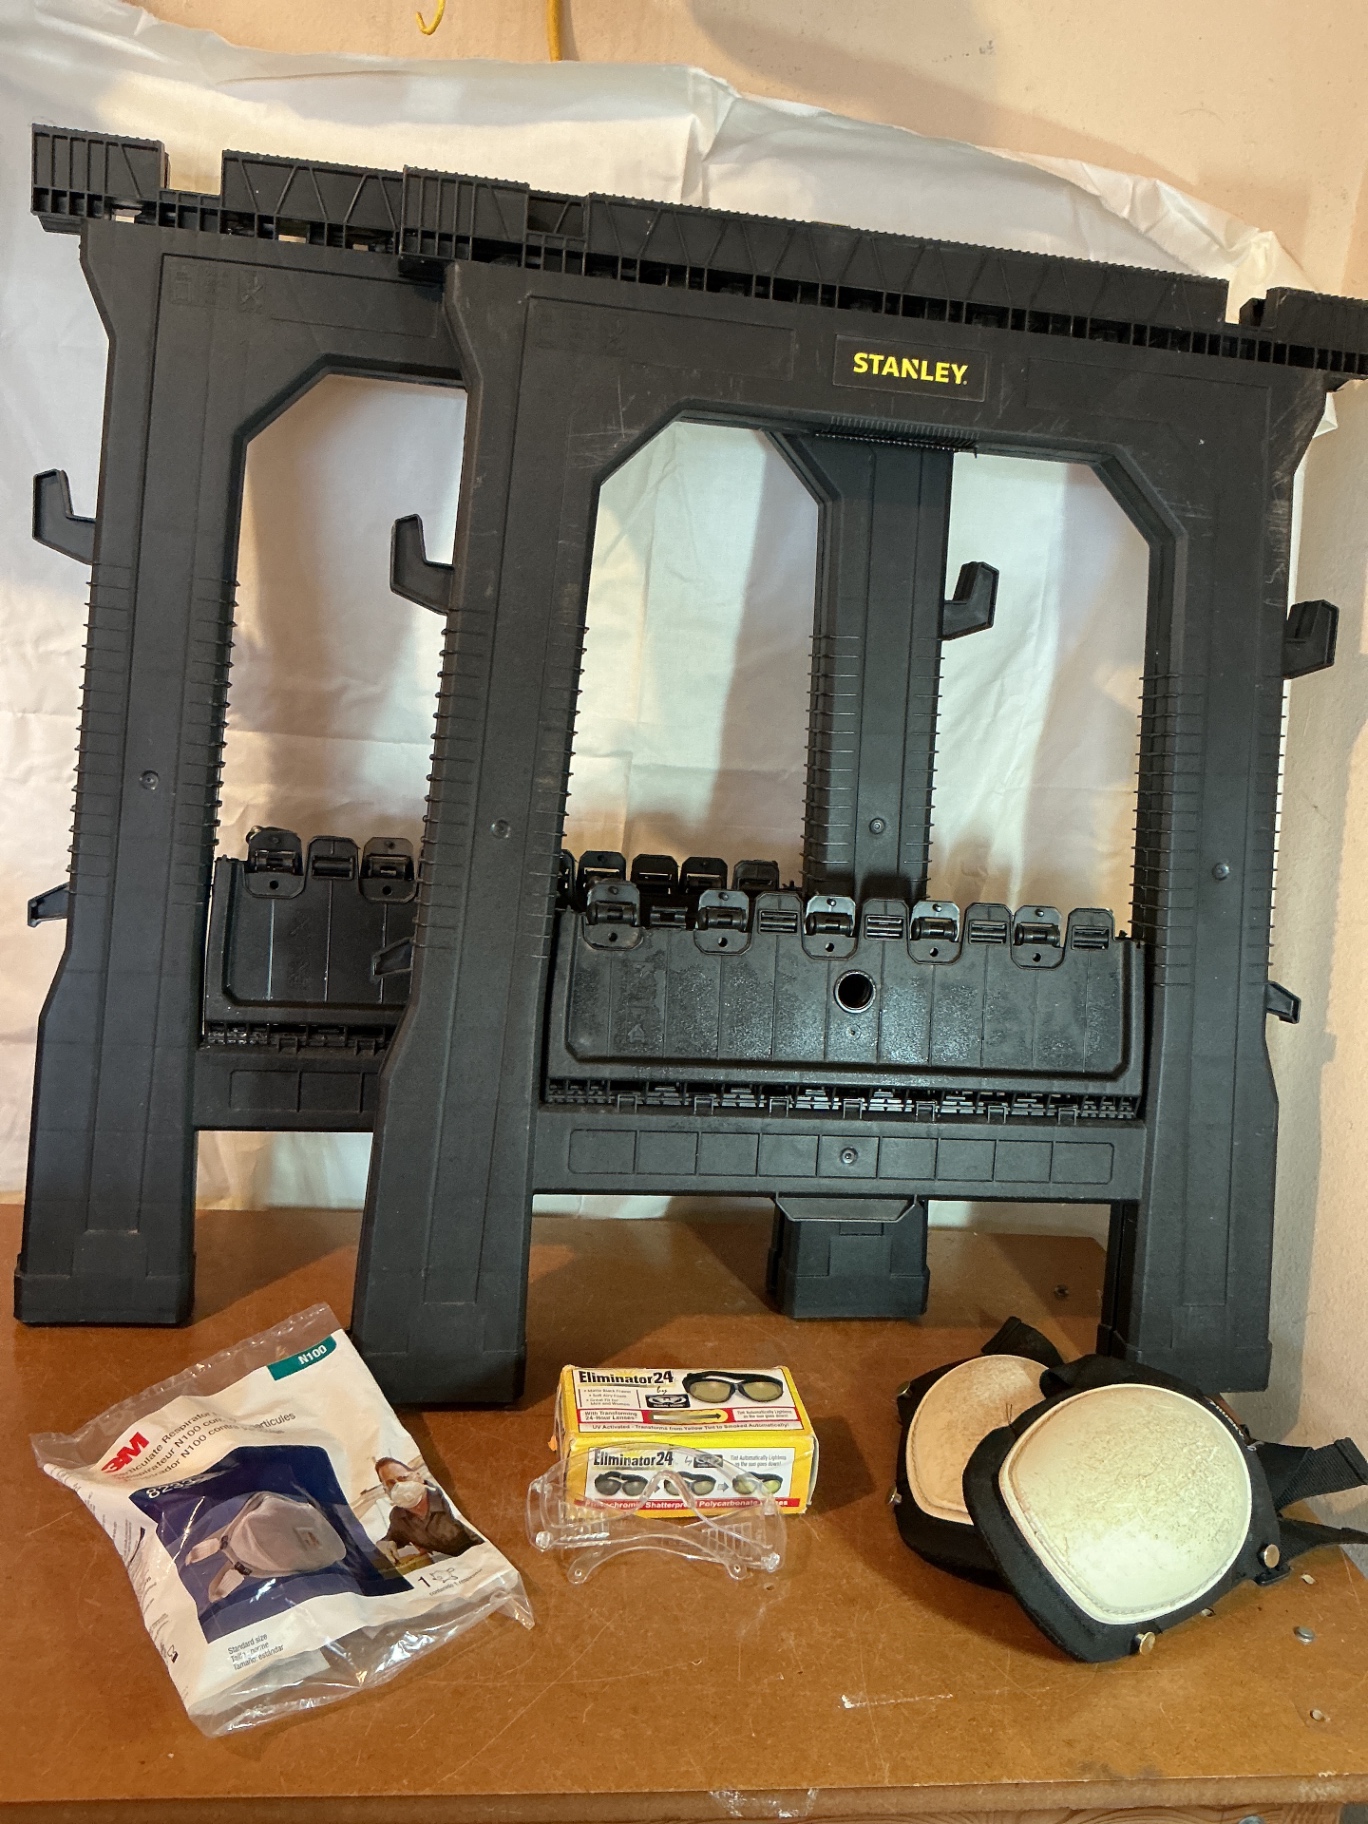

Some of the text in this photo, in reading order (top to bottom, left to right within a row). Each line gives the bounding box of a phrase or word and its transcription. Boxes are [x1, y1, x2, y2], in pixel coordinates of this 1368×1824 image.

[853, 352, 968, 385] STANLEY
[297, 1344, 328, 1365] N100
[161, 1410, 210, 1444] Respirator
[174, 1425, 202, 1448] N100
[100, 1431, 150, 1474] 3M
[182, 1434, 208, 1459] N100
[418, 1576, 431, 1588] 1
[255, 1633, 268, 1642] size
